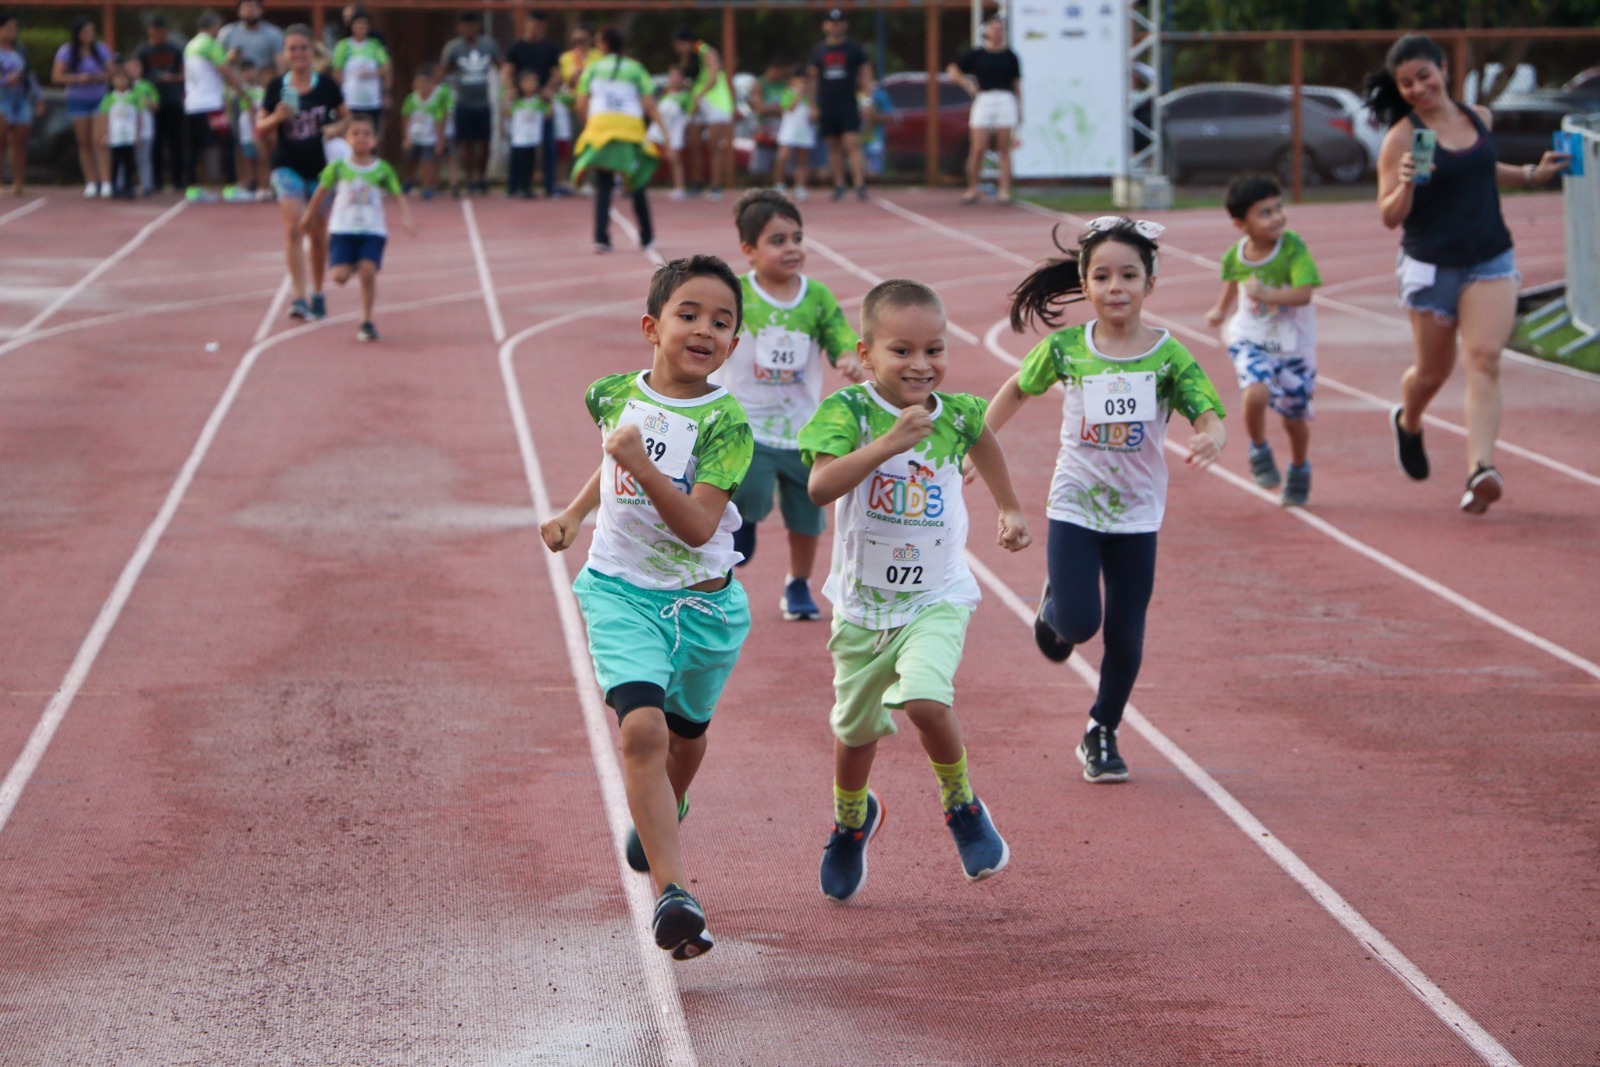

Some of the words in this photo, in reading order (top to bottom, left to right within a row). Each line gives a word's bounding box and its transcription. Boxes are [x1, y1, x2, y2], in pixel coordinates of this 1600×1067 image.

[771, 349, 796, 365] 245
[1105, 398, 1136, 416] 039
[644, 415, 669, 434] KIDS
[1081, 416, 1145, 447] KIDS
[869, 475, 944, 518] KIDS
[866, 510, 902, 525] CORRIDA
[904, 517, 944, 527] ECOLÓGICA
[893, 547, 920, 559] KIDS
[886, 565, 923, 584] 072
